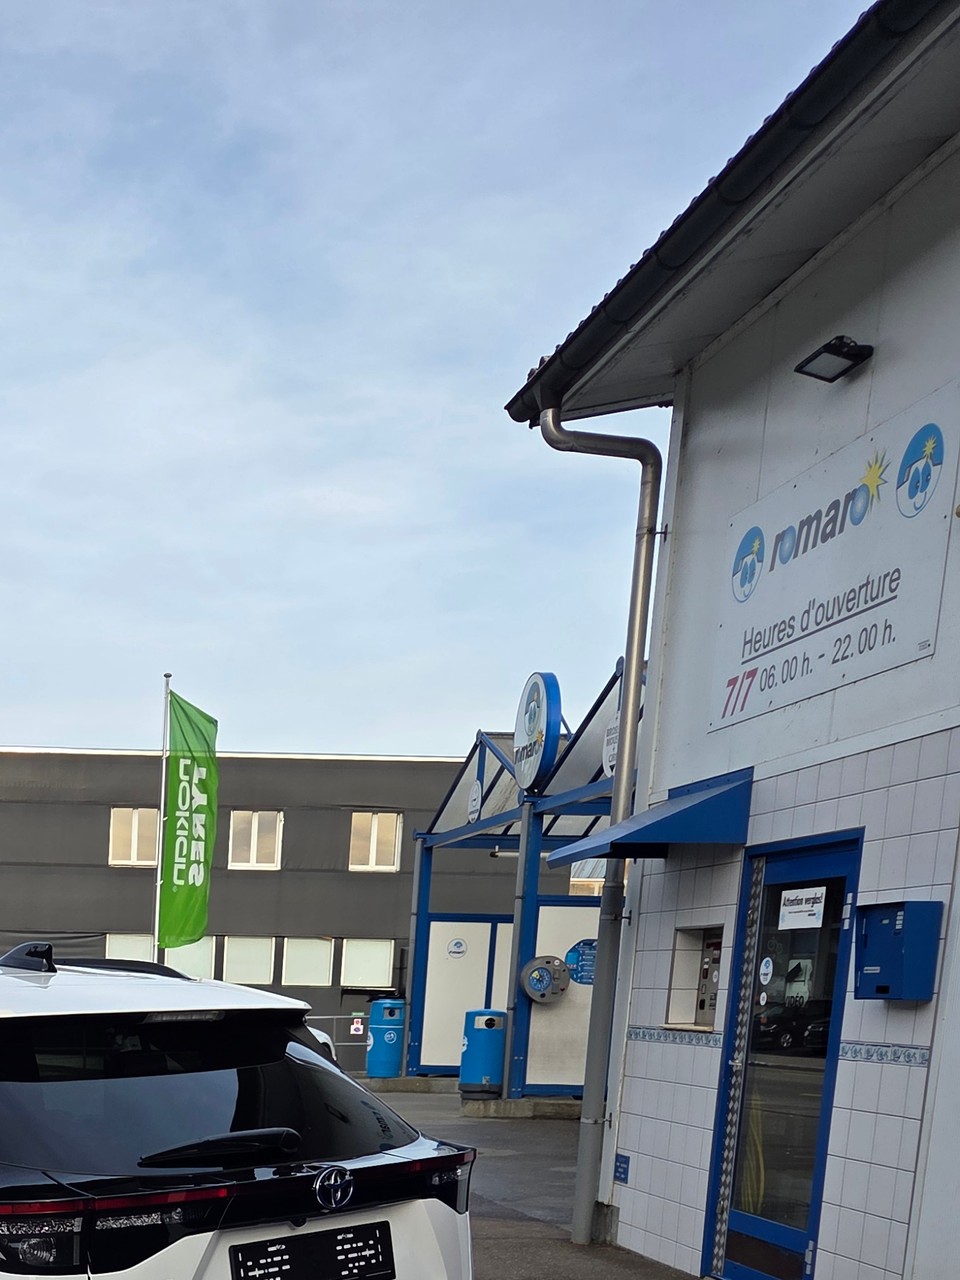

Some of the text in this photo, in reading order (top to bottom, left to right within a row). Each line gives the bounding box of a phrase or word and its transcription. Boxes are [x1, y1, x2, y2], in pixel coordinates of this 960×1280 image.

[769, 483, 871, 573] romaro
[742, 567, 901, 658] Heures d'ouverture
[721, 667, 759, 719] 7/7
